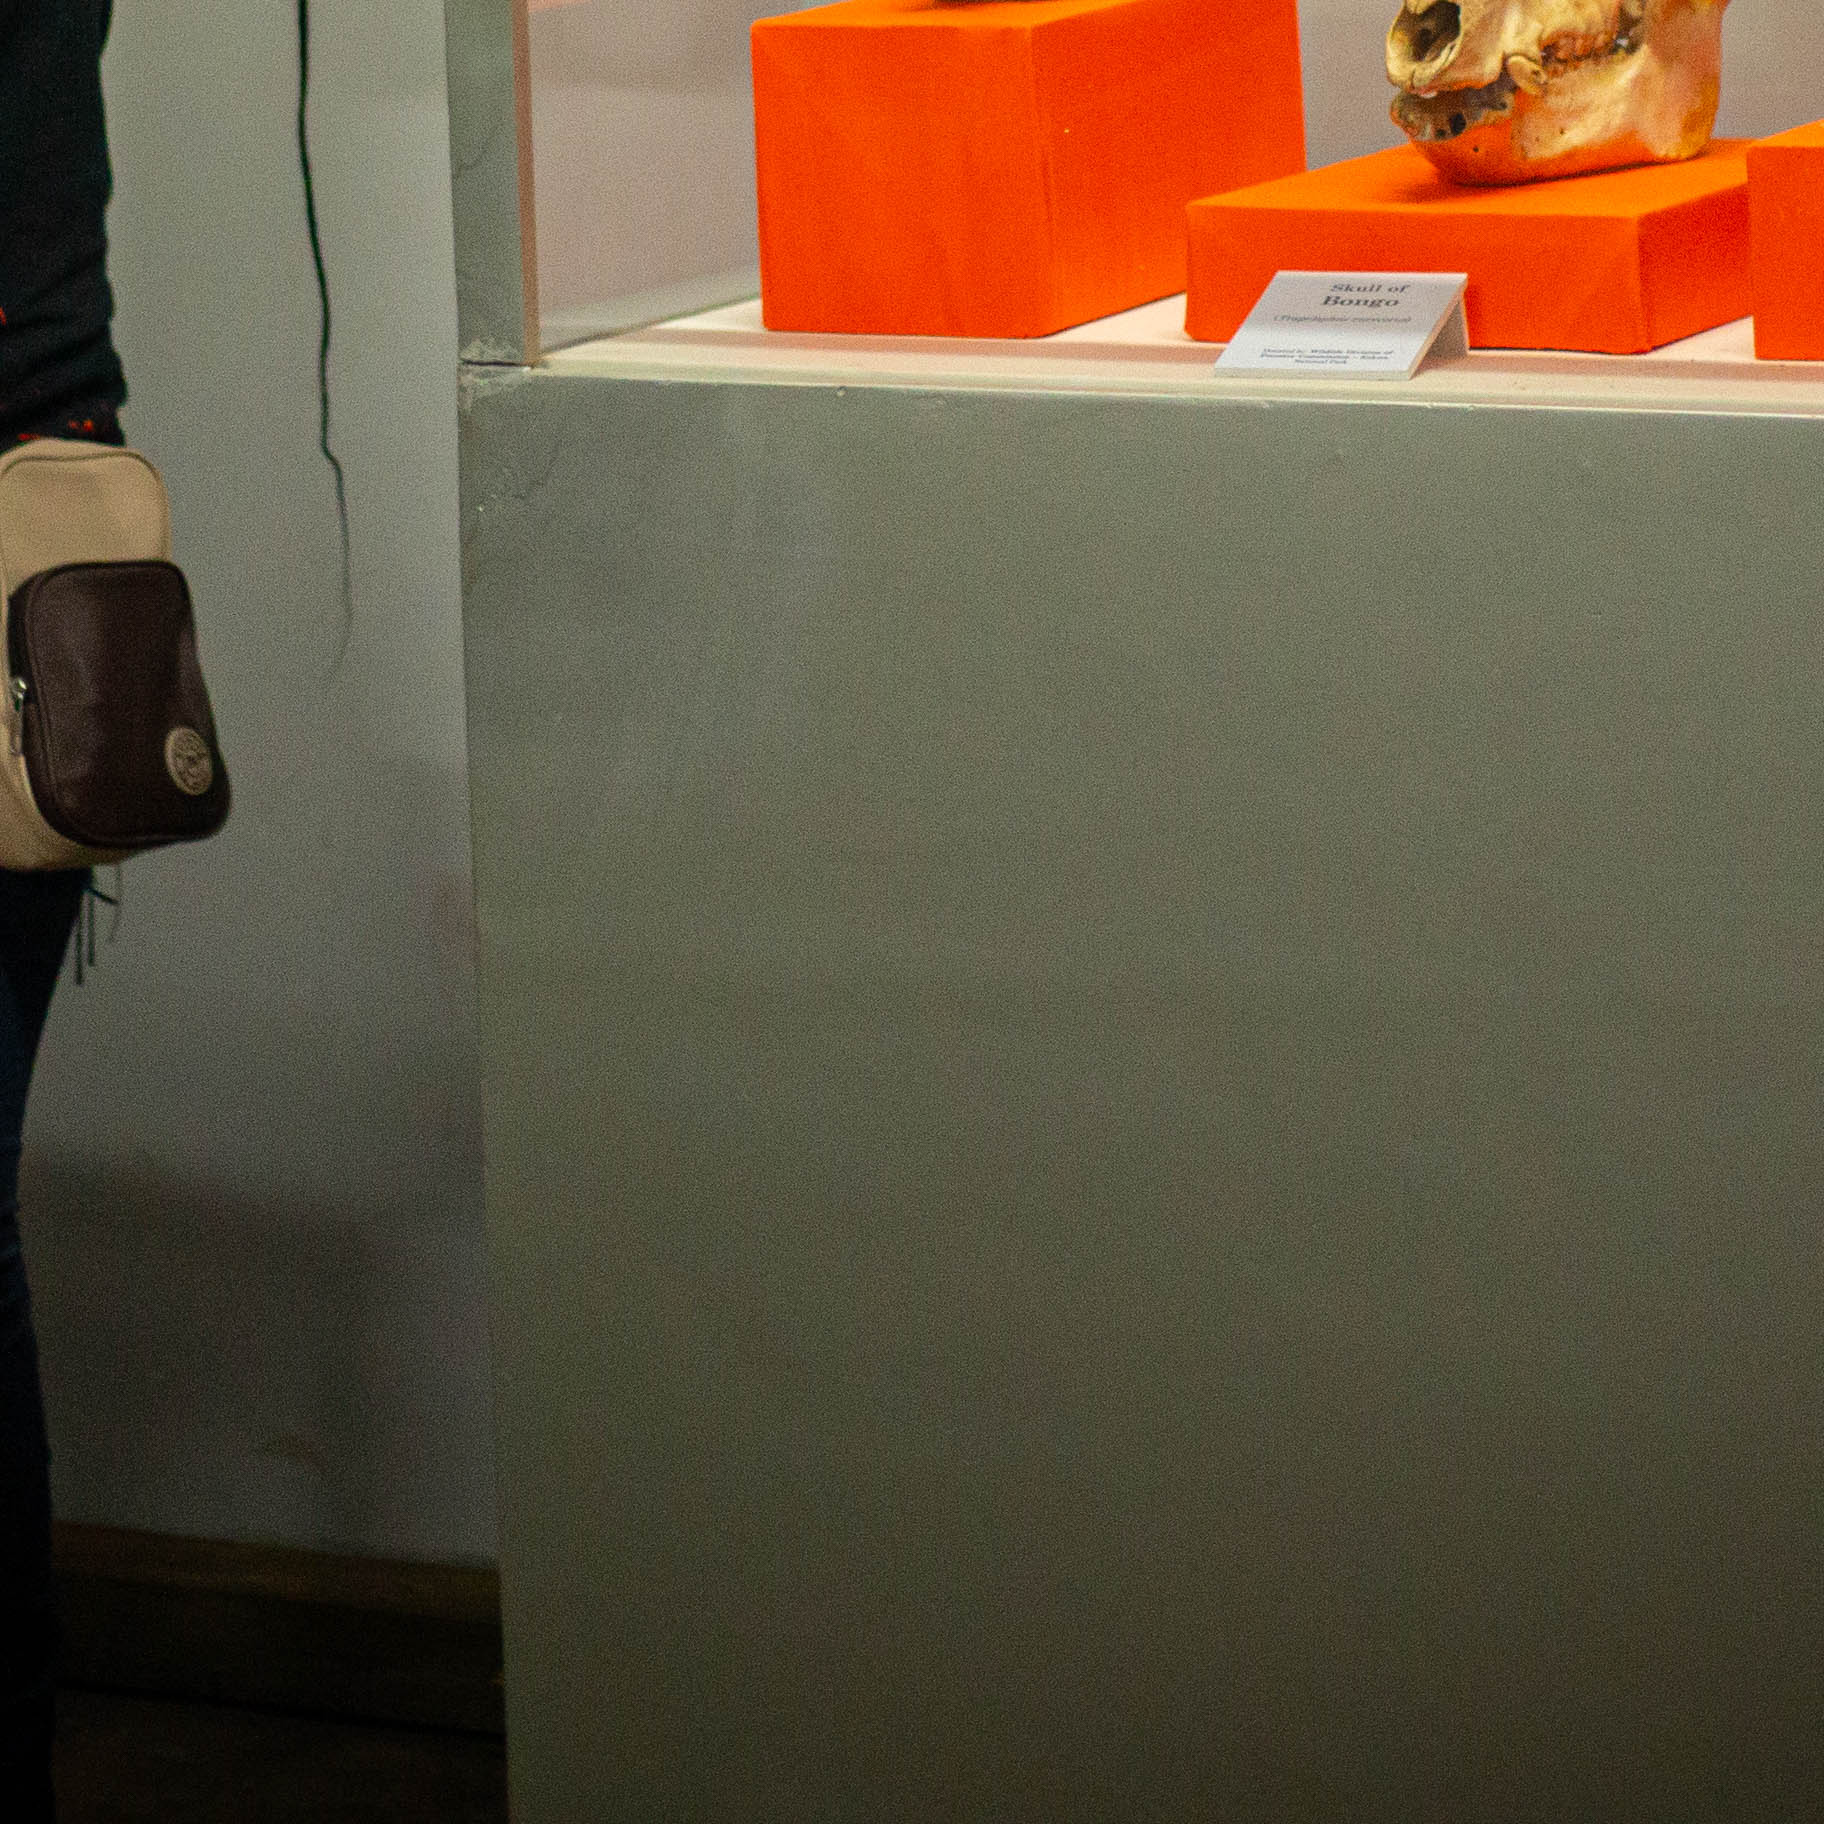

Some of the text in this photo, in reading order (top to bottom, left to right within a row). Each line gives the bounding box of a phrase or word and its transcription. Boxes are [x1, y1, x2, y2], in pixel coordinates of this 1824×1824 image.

[1330, 283, 1411, 293] Skull of
[1323, 295, 1399, 308] Bongo
